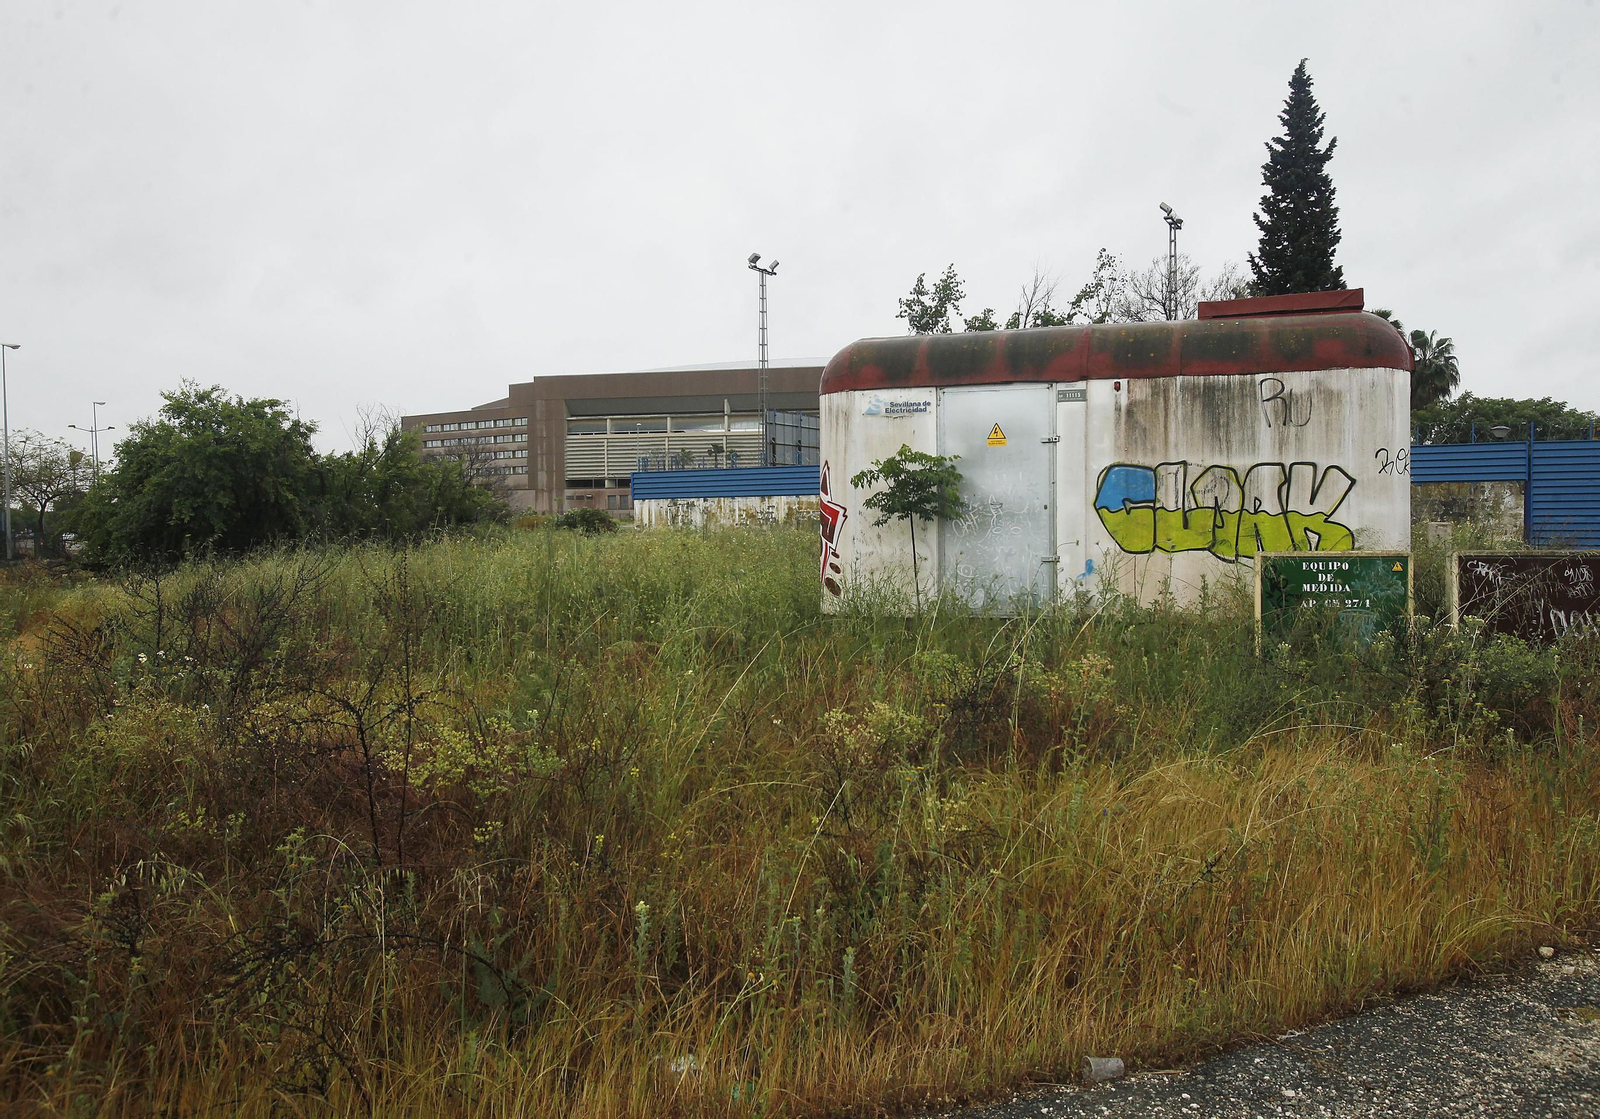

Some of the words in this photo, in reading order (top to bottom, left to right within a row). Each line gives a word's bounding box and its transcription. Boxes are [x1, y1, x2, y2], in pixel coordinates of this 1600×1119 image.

[884, 406, 927, 414] Electricidad
[1302, 561, 1349, 572] EQUIPO
[1318, 573, 1334, 582] DE
[1302, 583, 1350, 592] MEDIDA
